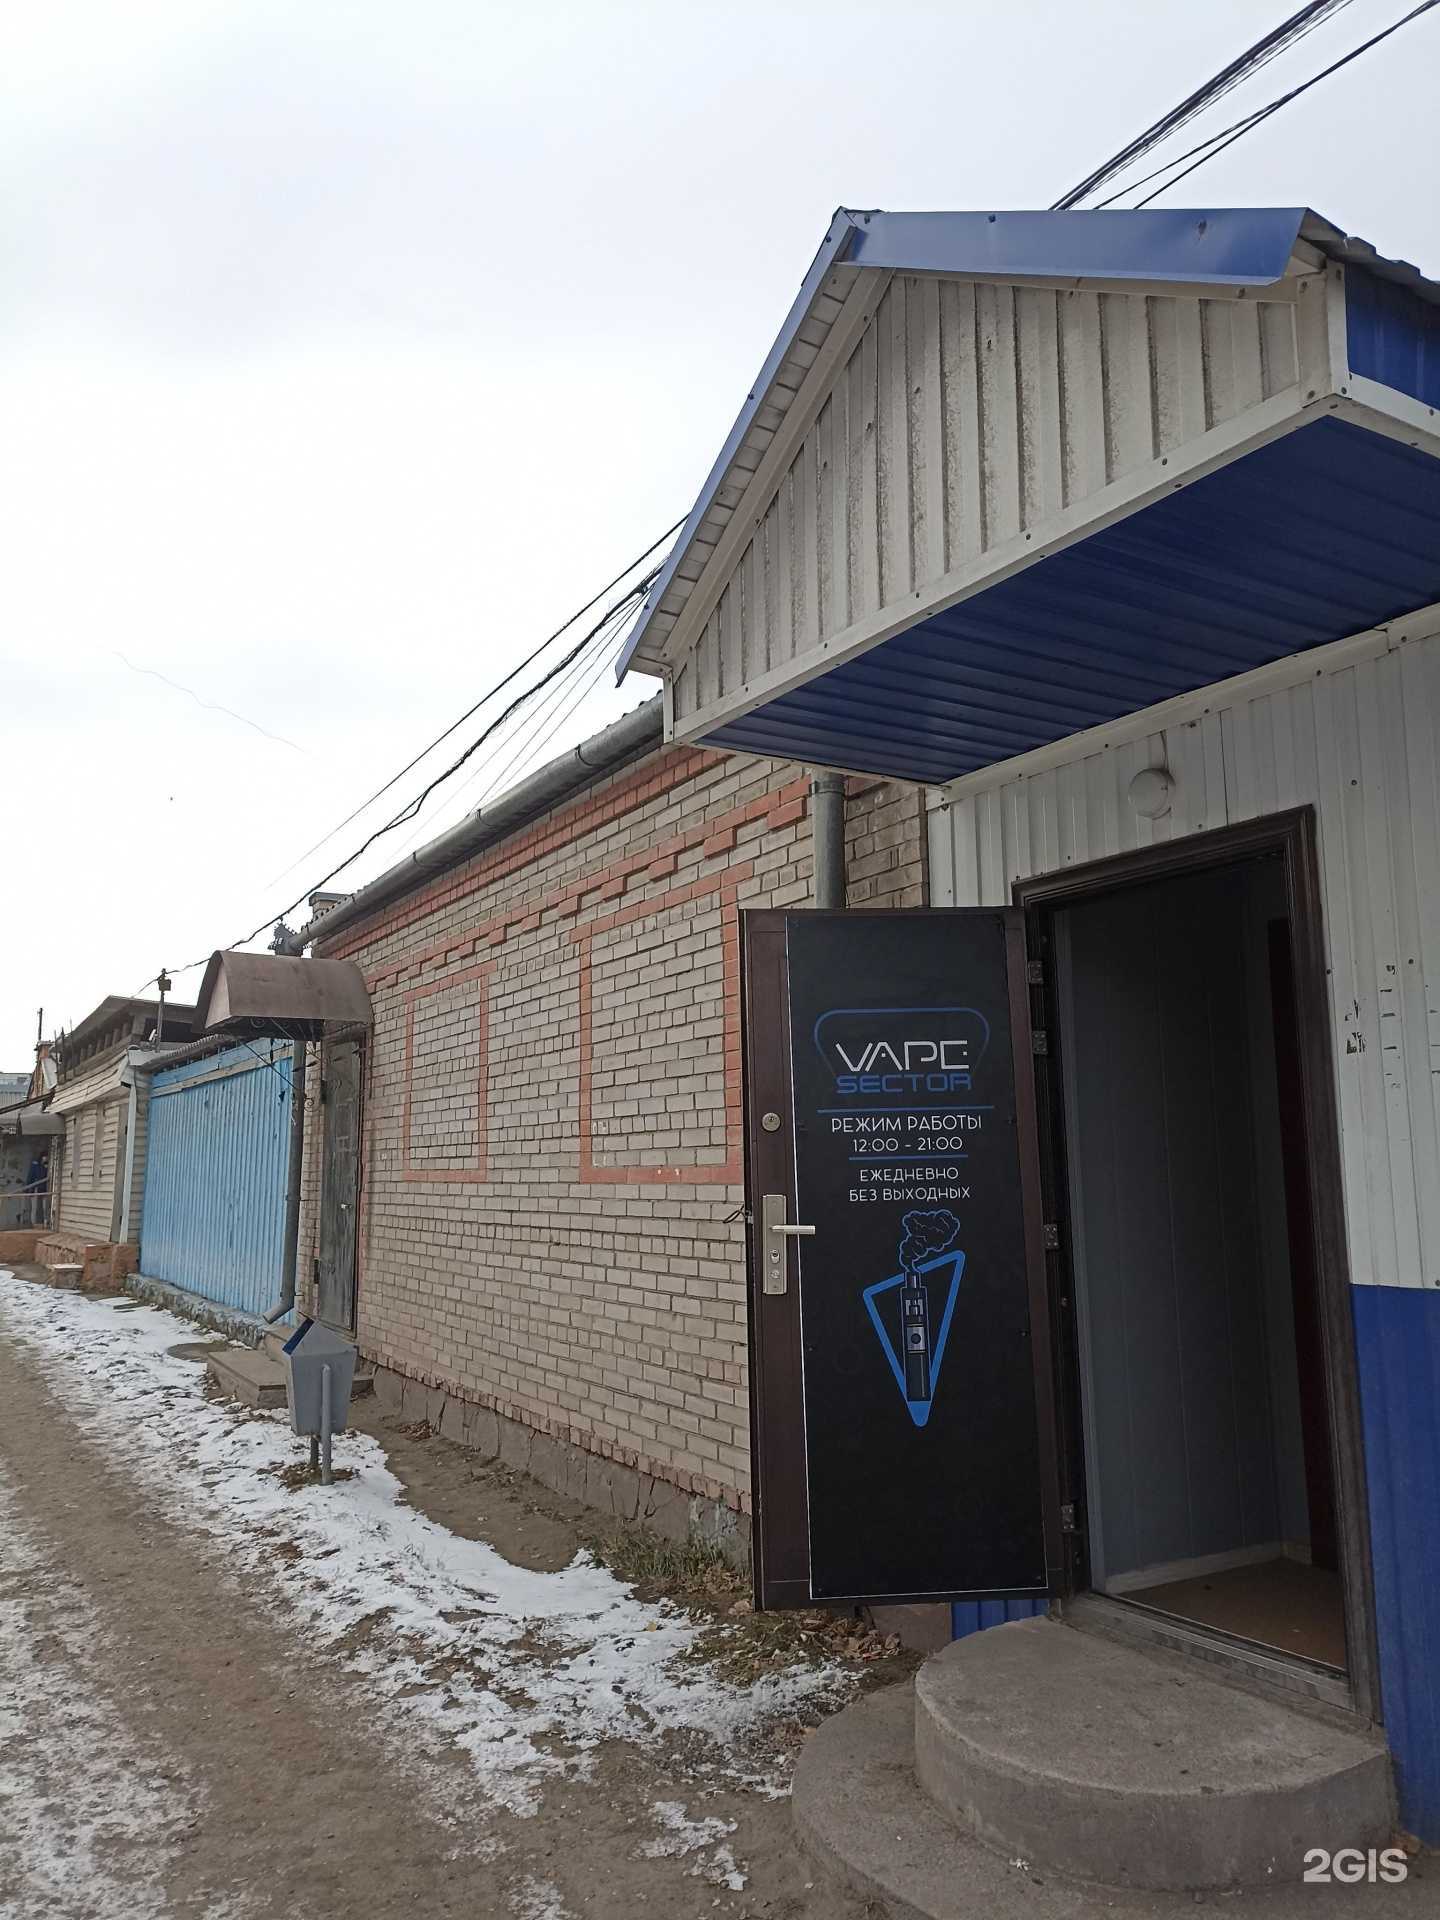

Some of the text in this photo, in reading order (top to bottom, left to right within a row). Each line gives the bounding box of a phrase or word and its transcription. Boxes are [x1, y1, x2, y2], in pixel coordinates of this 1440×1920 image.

[835, 1040, 969, 1072] VAPE
[836, 1073, 972, 1094] SECTOR
[831, 1115, 982, 1132] РЕЖИМ РАБОТЫ
[853, 1138, 899, 1152] 12:00
[917, 1136, 962, 1150] 21:00
[860, 1167, 959, 1183] ЕЖЕДНЕВНО
[849, 1186, 971, 1202] БЕЗ ВЫХОДНЫХ
